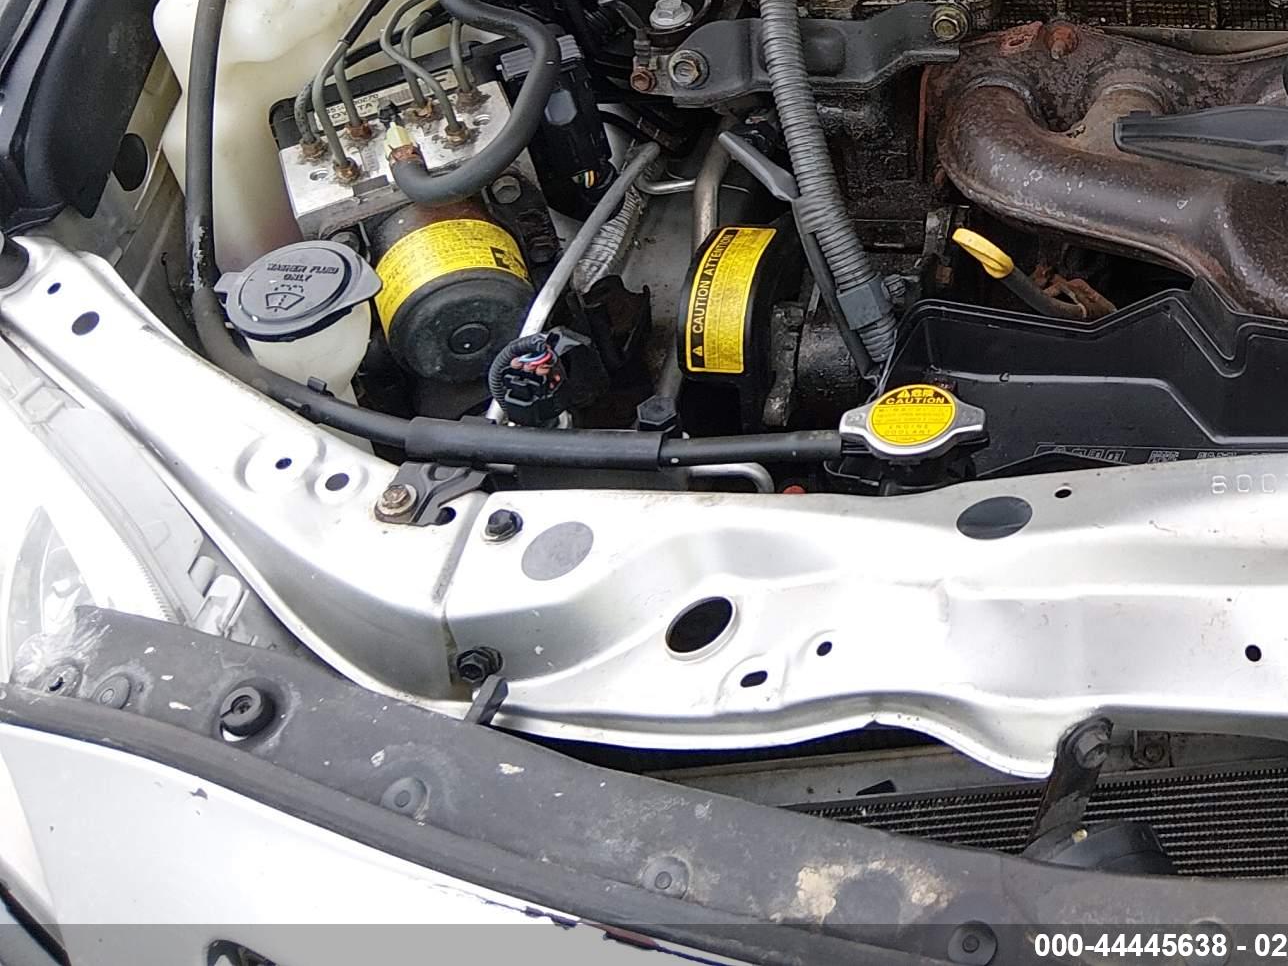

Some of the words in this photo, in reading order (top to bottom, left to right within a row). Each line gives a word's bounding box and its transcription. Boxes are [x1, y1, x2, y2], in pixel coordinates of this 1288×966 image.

[266, 263, 308, 274] WASHER
[309, 265, 340, 275] FLUID
[283, 273, 313, 283] ONLY
[692, 280, 710, 334] CAUTION
[703, 234, 735, 276] ATTENTION
[885, 396, 945, 405] CAUTION
